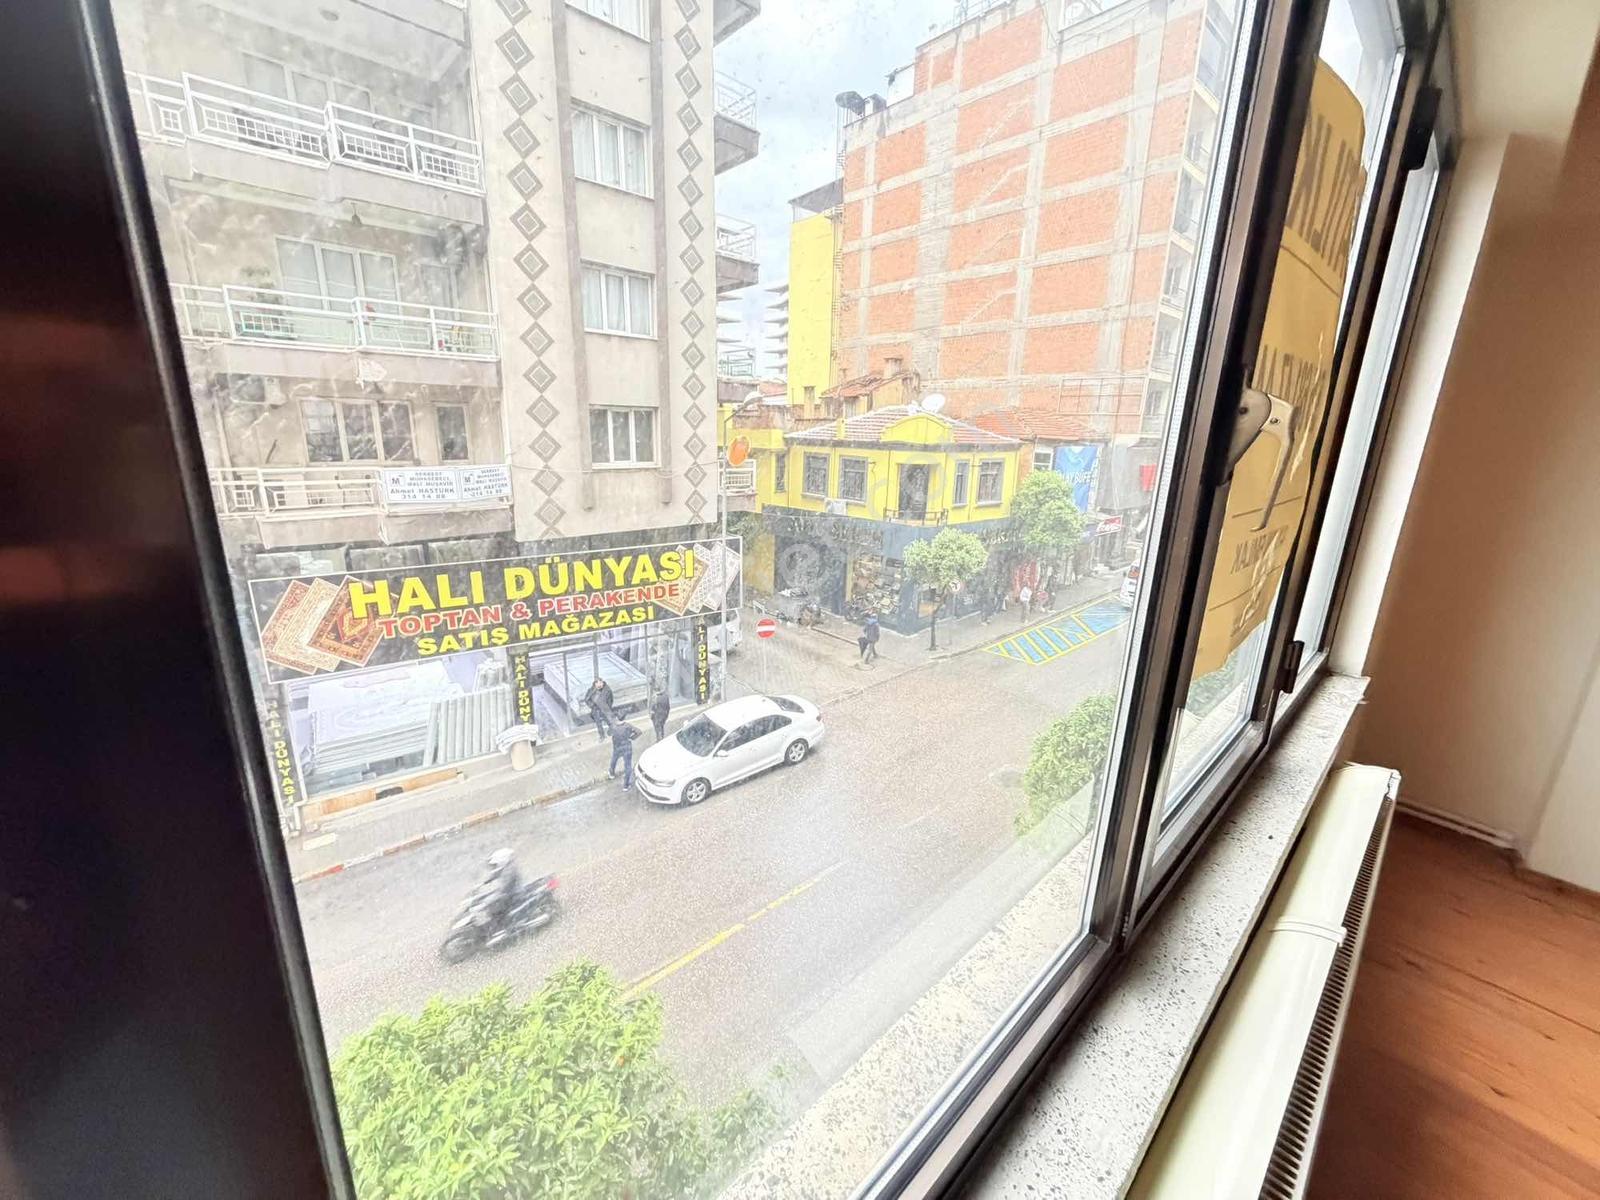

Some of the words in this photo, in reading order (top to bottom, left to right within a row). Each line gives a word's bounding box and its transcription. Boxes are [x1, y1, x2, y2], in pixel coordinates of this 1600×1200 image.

[349, 571, 485, 619] HALI
[504, 549, 695, 601] DÜNYASI
[378, 606, 502, 639] TOPTAN
[511, 602, 532, 620] &
[538, 583, 680, 617] PERAKENDE
[418, 627, 509, 656] SATIŞ
[518, 606, 655, 640] MAĞAZASI
[514, 656, 527, 688] HALI
[518, 690, 531, 726] DÜNY
